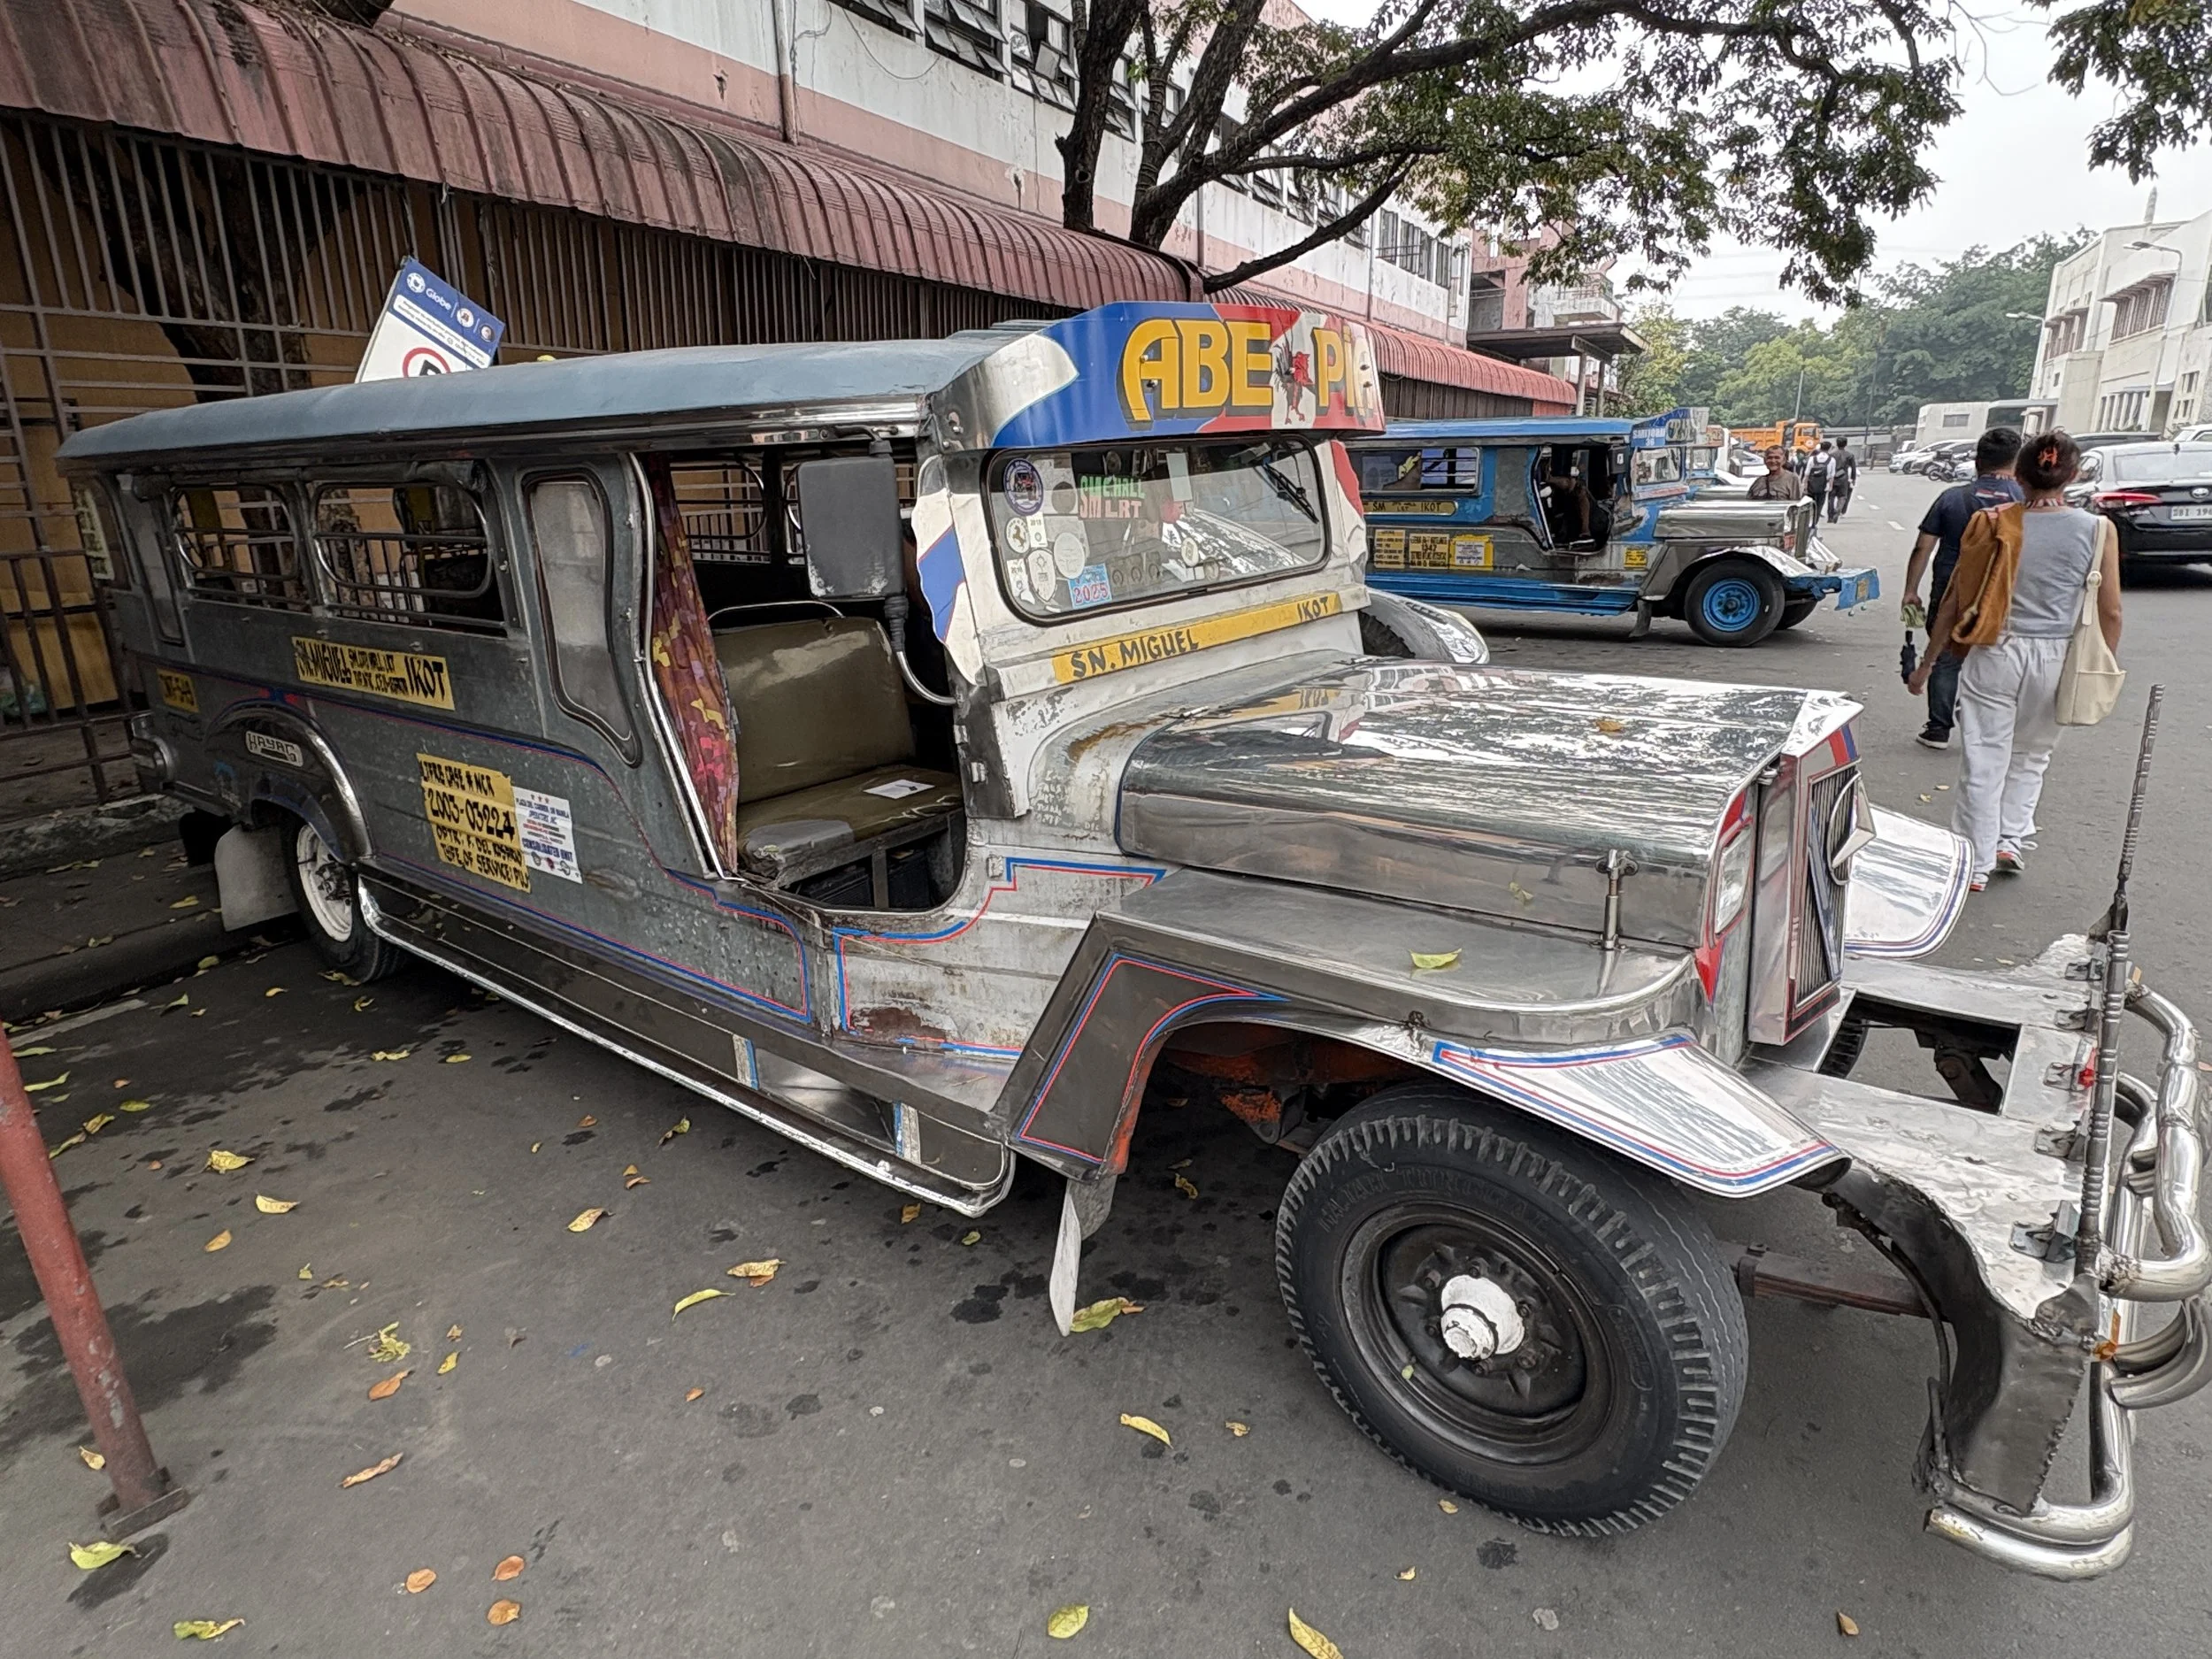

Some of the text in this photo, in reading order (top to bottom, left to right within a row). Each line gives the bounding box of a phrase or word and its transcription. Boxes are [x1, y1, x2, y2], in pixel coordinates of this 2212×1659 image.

[426, 288, 452, 311] Globe
[1119, 319, 1274, 425] ABE
[1105, 498, 1142, 518] LRT
[1373, 501, 1386, 511] SM
[1421, 501, 1441, 511] IKOT
[1073, 582, 1109, 604] 2025
[1296, 596, 1329, 621] IKOT
[404, 656, 446, 701] IKOT
[473, 772, 495, 796] NCR
[427, 787, 515, 842] 2003-03224
